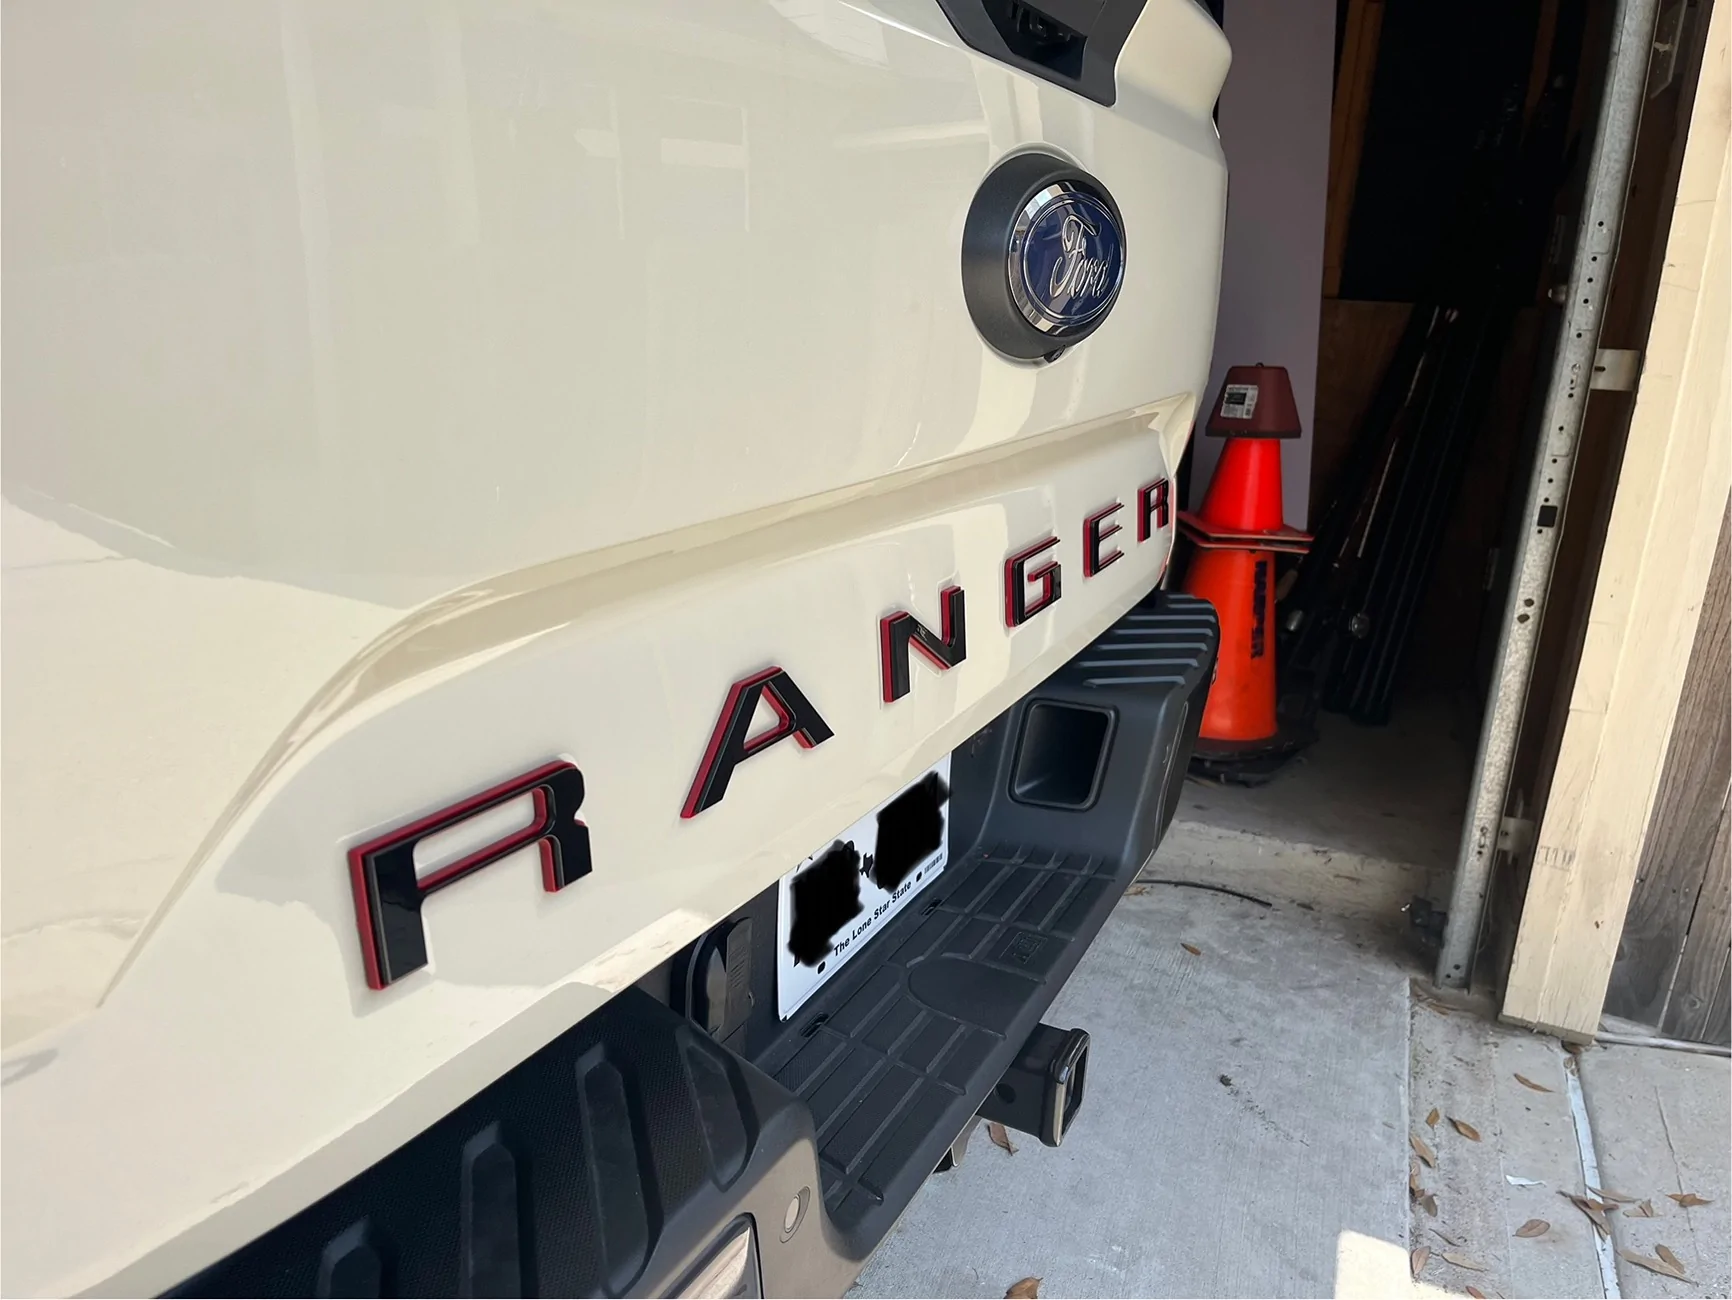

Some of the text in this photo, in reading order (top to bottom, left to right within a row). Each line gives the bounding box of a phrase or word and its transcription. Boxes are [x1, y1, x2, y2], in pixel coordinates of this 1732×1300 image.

[1049, 213, 1116, 299] Ford
[347, 477, 1169, 990] RANGER
[833, 881, 912, 957] The Lone Star State
